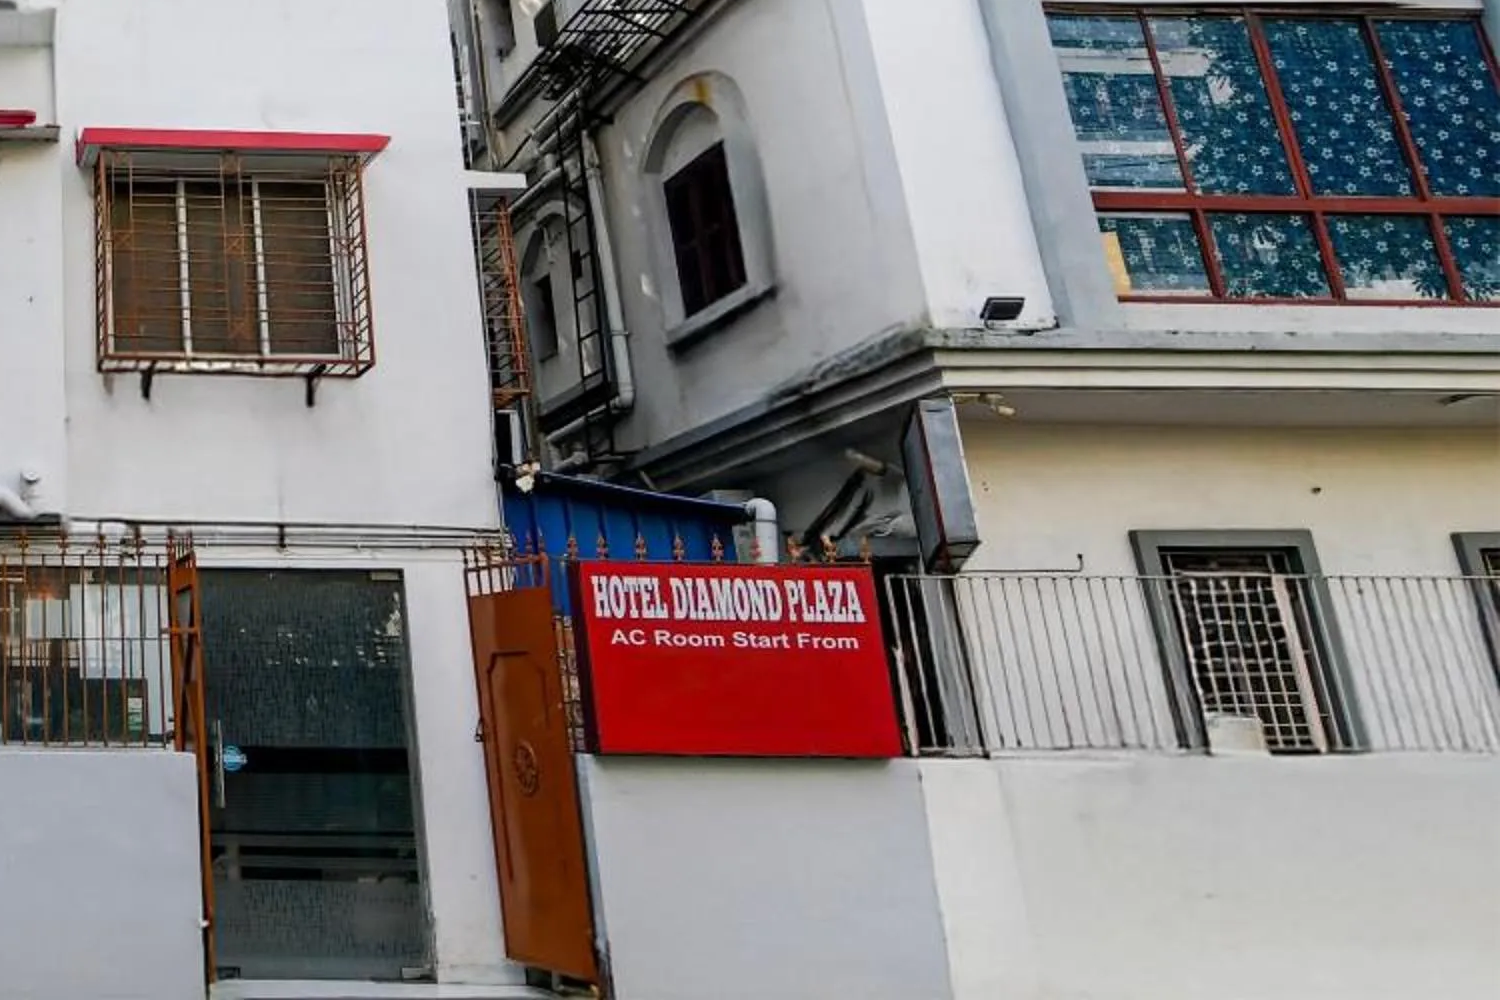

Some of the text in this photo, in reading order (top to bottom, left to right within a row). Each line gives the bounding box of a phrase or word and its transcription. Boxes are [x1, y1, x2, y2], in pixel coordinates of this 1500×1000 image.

[591, 576, 866, 623] HOTEL DIAMOND PLAZA
[611, 629, 859, 649] AC Room Start From
